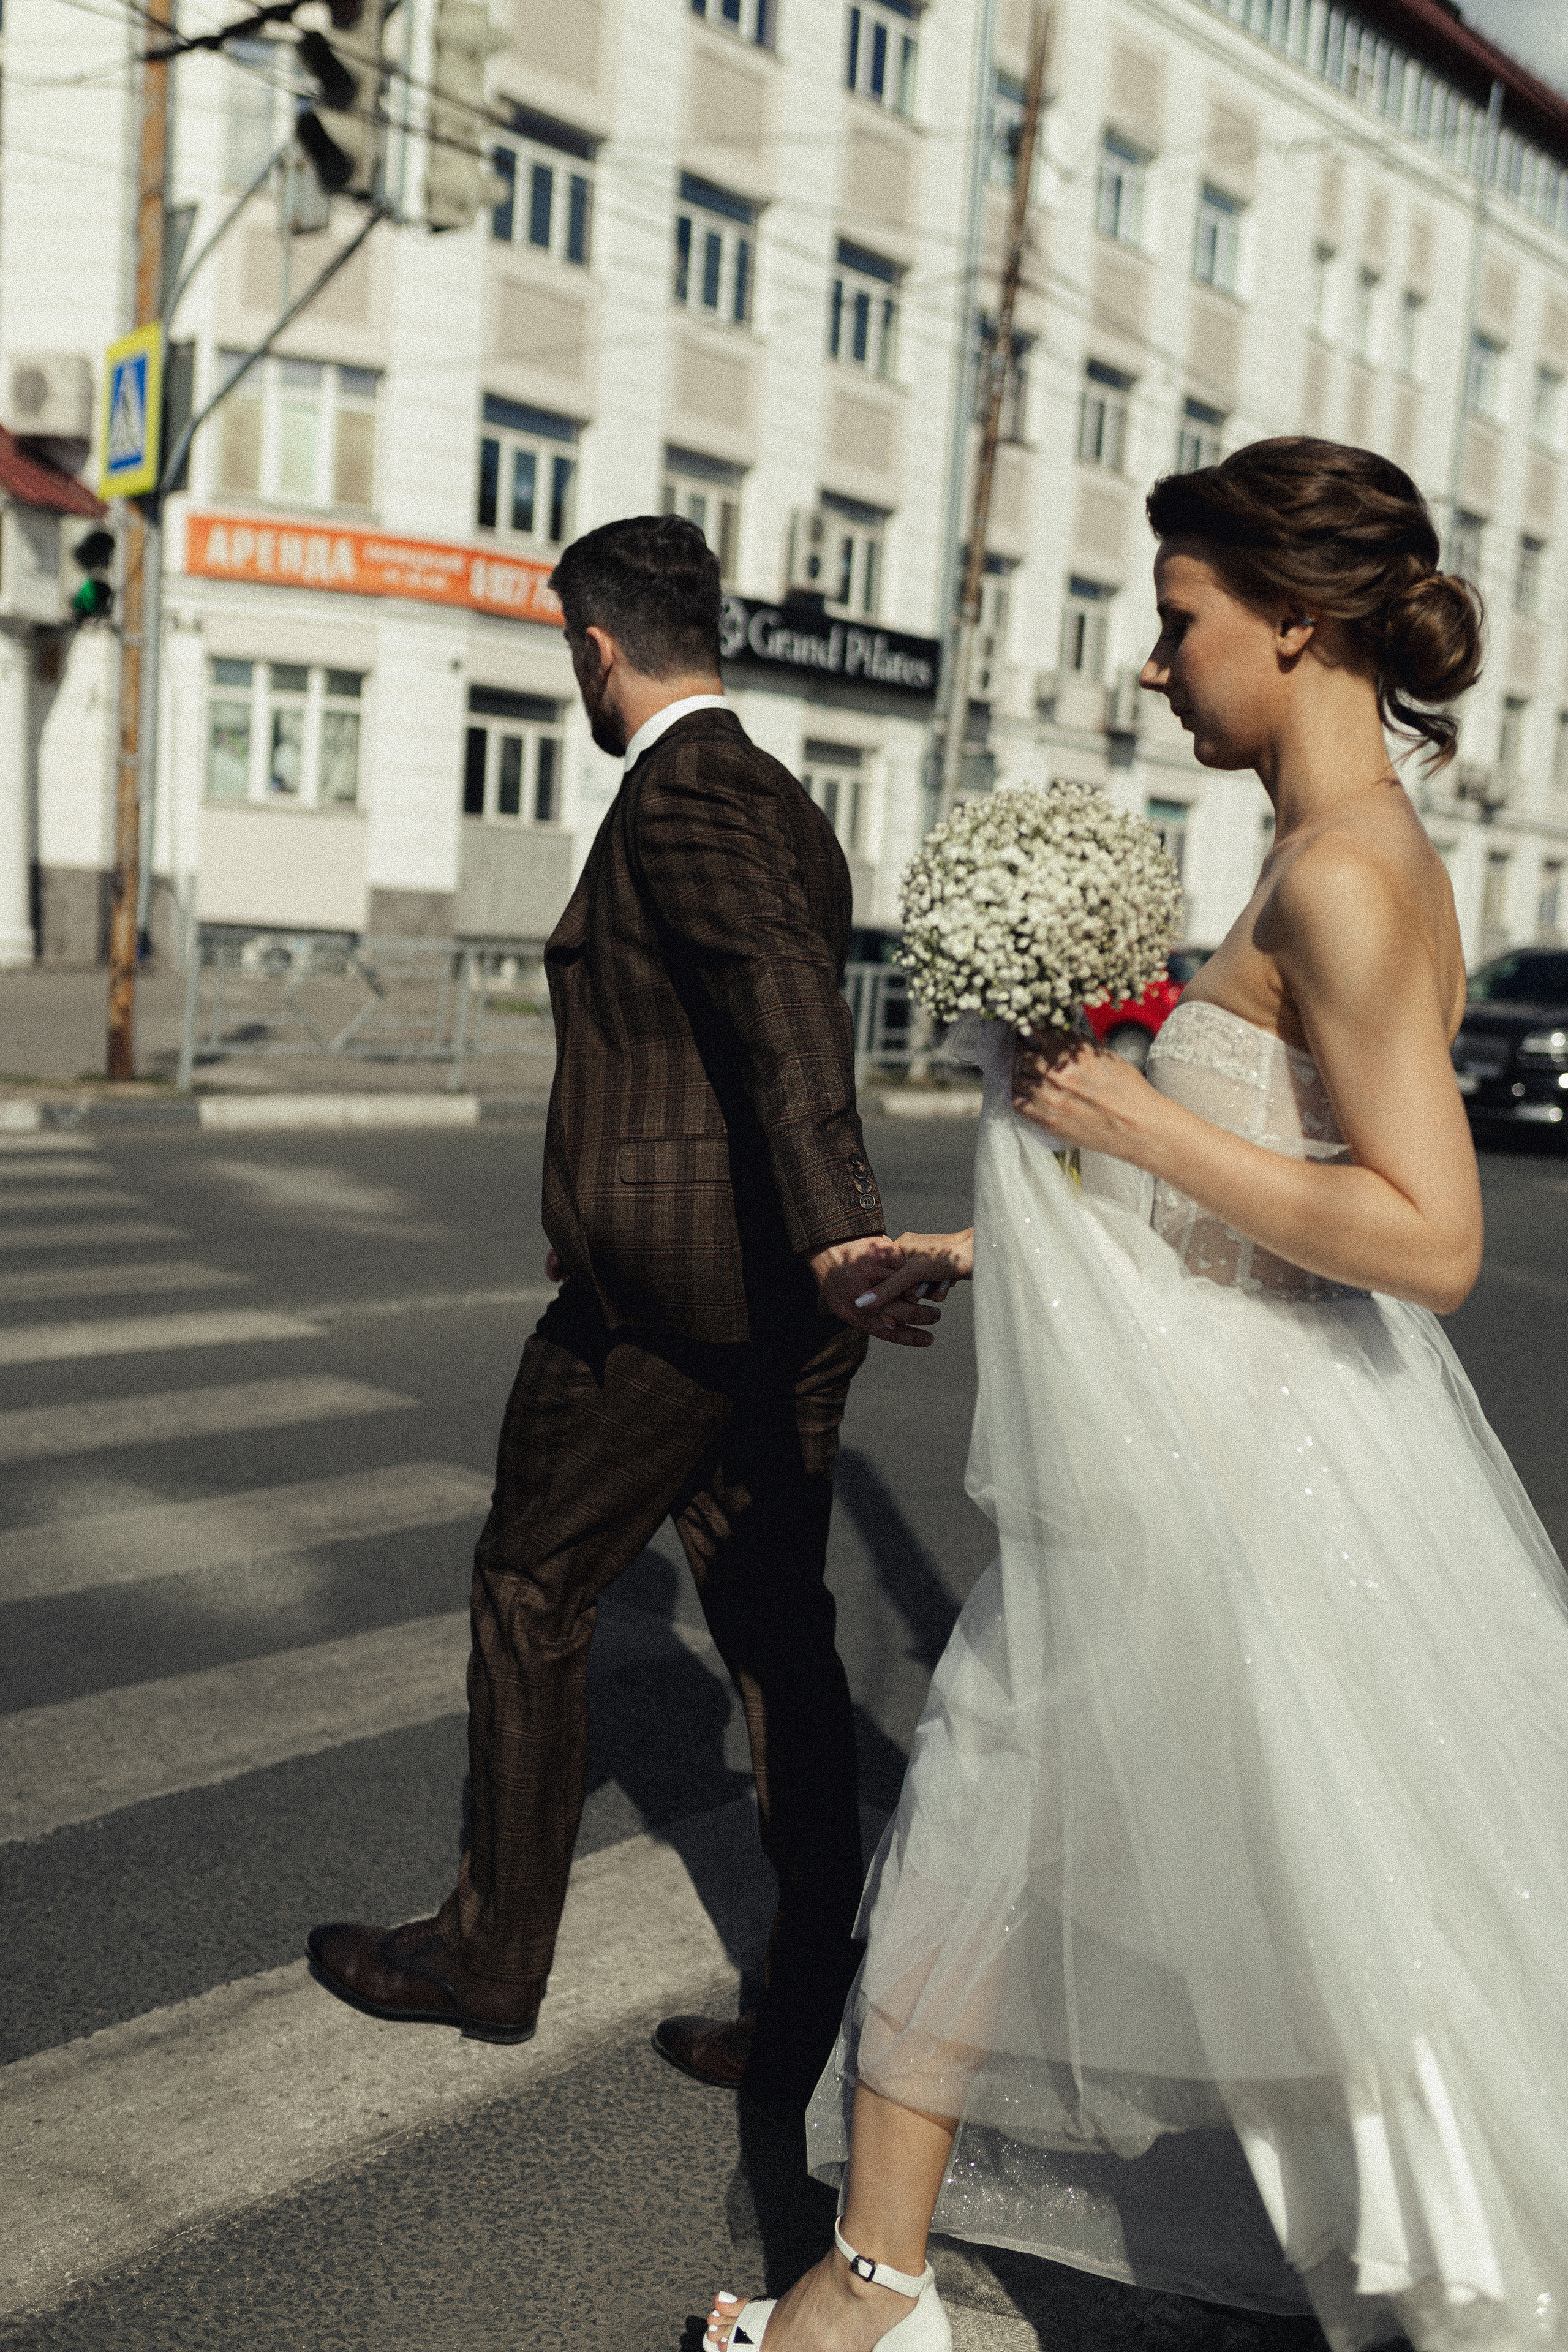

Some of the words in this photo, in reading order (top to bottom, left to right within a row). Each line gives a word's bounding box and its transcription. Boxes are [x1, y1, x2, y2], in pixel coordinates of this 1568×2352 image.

[205, 524, 357, 584] АРЕНДА
[748, 608, 843, 671] Grand
[845, 628, 933, 688] Pilates
